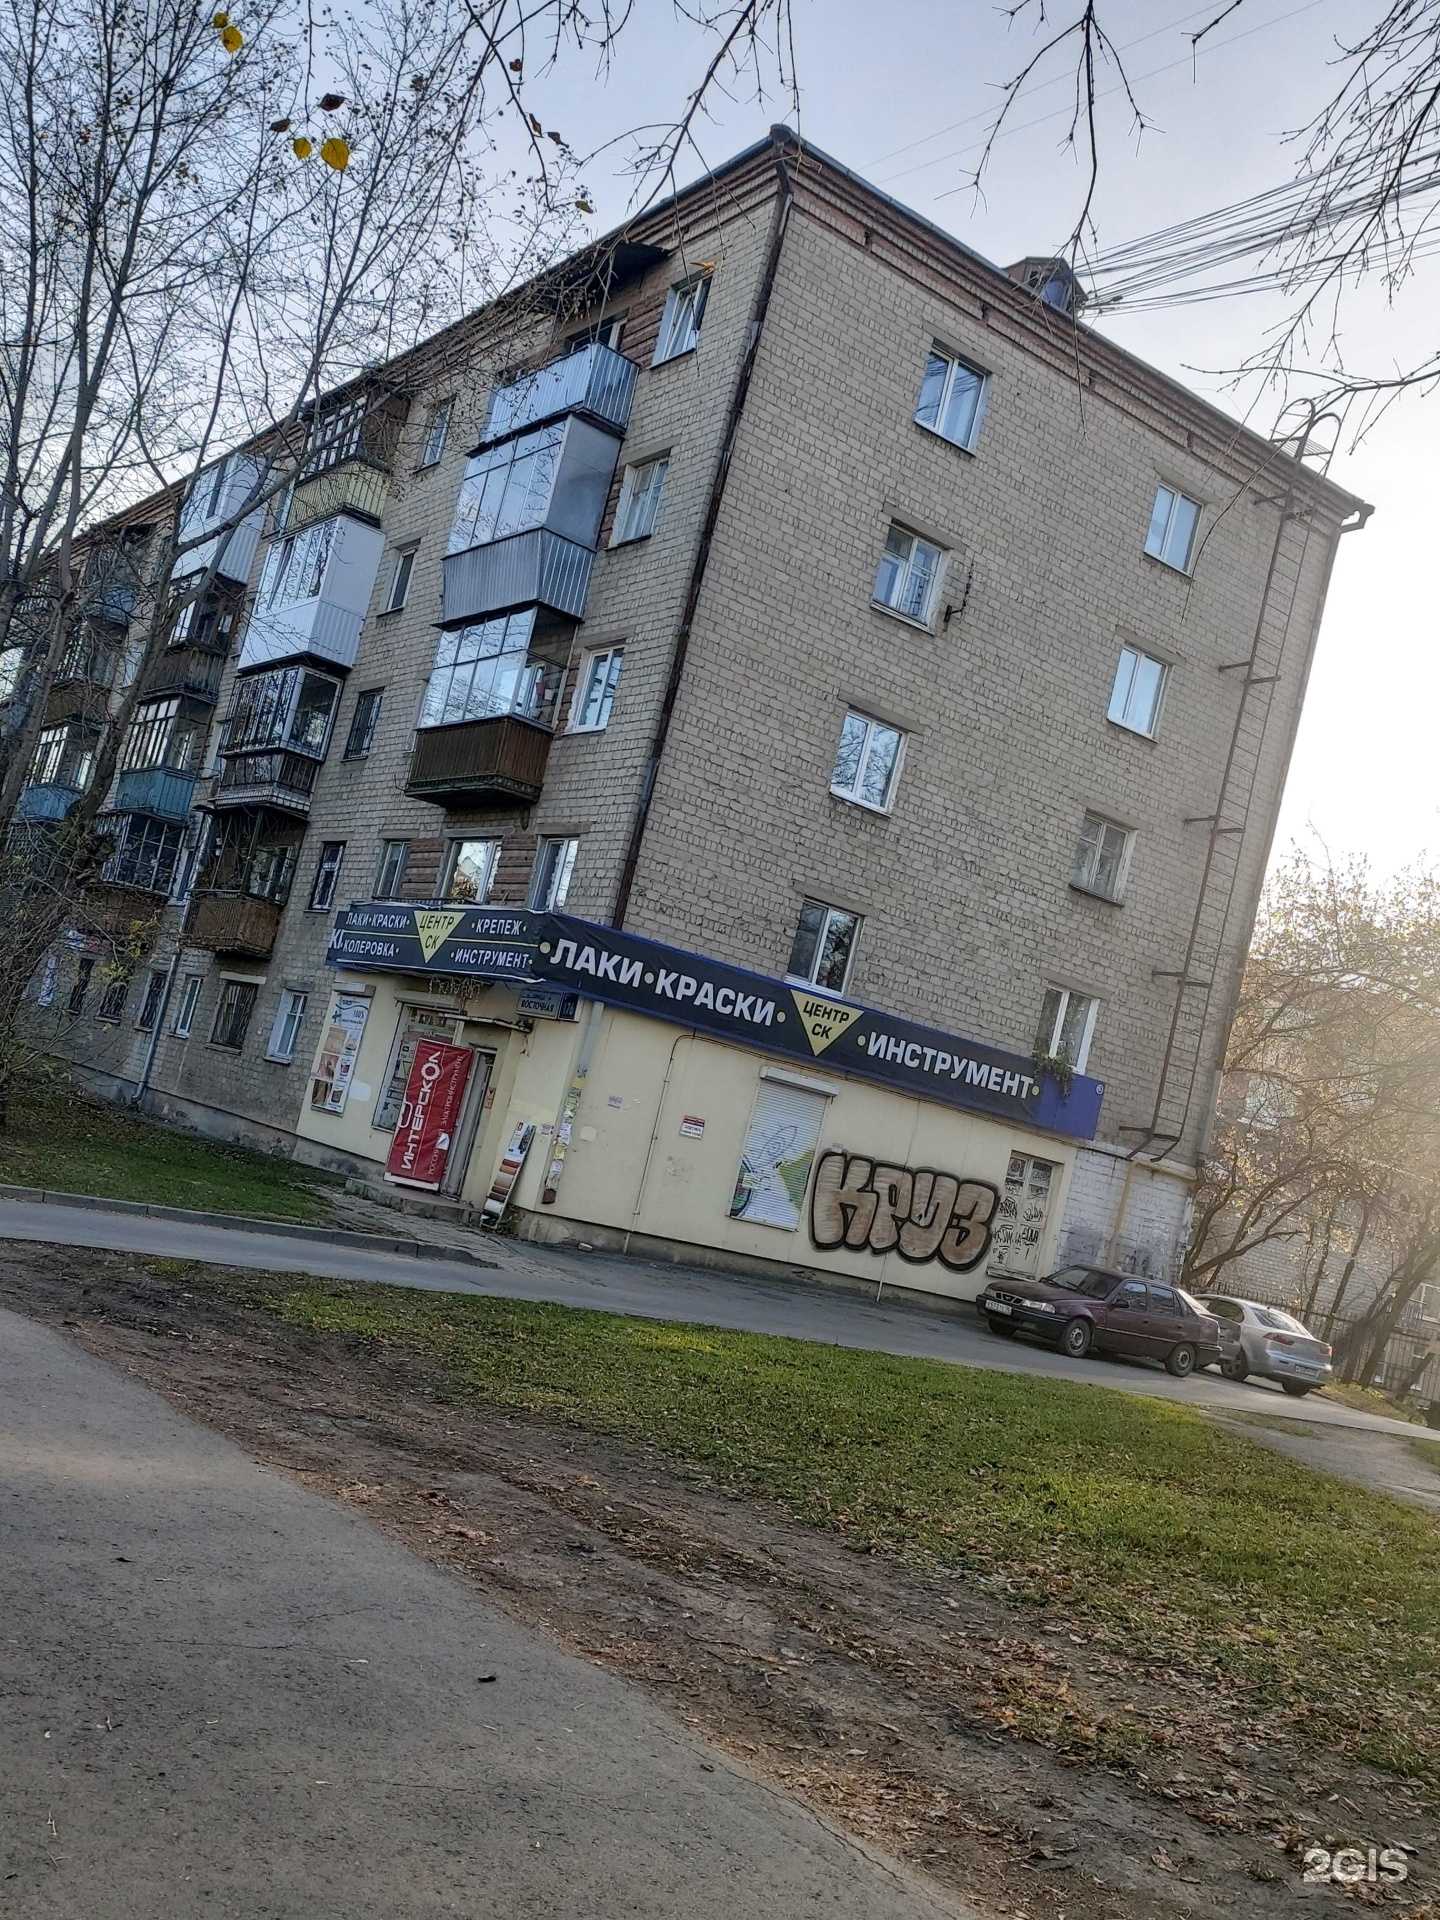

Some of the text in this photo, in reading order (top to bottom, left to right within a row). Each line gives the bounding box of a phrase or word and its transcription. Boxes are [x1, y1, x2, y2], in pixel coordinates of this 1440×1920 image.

[420, 915, 455, 931] ЦЕНТР
[475, 919, 522, 935] КРЕПЕЖ
[343, 940, 395, 957] КОЛЕРОВКА
[425, 935, 440, 949] СК
[454, 948, 530, 968] ИНСТРУМЕНТ
[550, 938, 776, 1026] ЛАКИ КРАСКИ
[803, 1000, 850, 1025] ЦЕНТР
[811, 1023, 833, 1040] СК
[867, 1031, 1035, 1099] ИНСТРУМЕНТ
[401, 1051, 441, 1170] ИНТЕРСКОЛ
